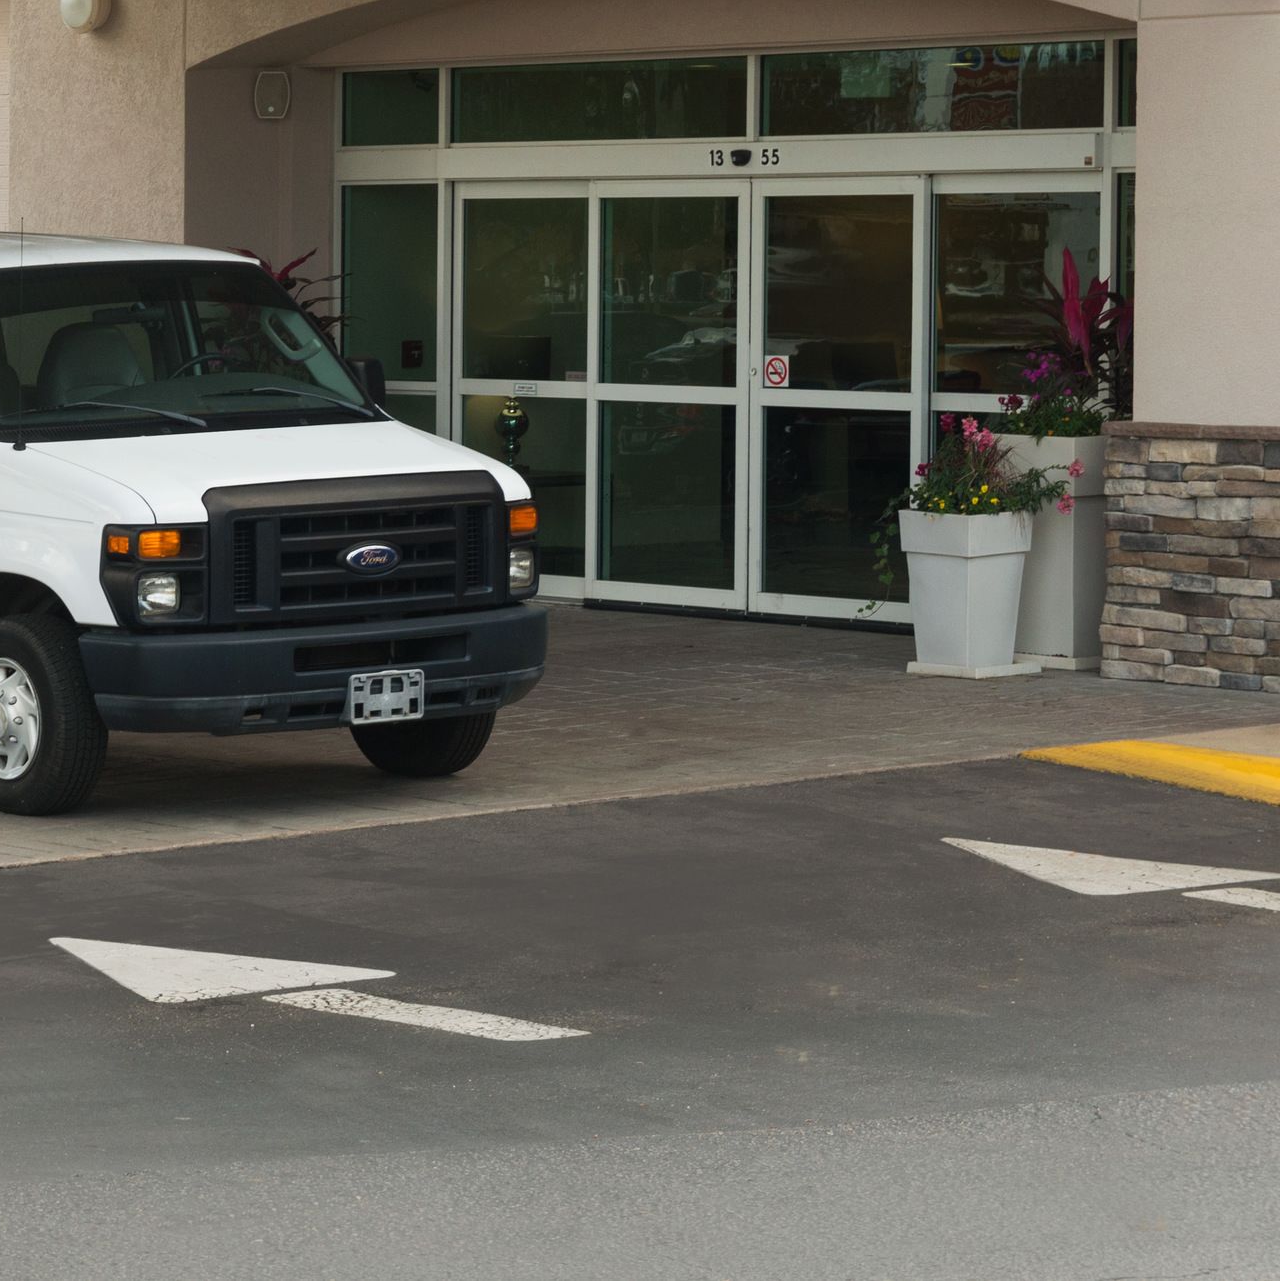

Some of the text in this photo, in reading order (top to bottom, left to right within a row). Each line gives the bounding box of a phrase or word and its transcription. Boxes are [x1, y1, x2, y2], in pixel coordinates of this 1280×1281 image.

[709, 148, 780, 166] 13 55
[360, 549, 389, 566] Ford
